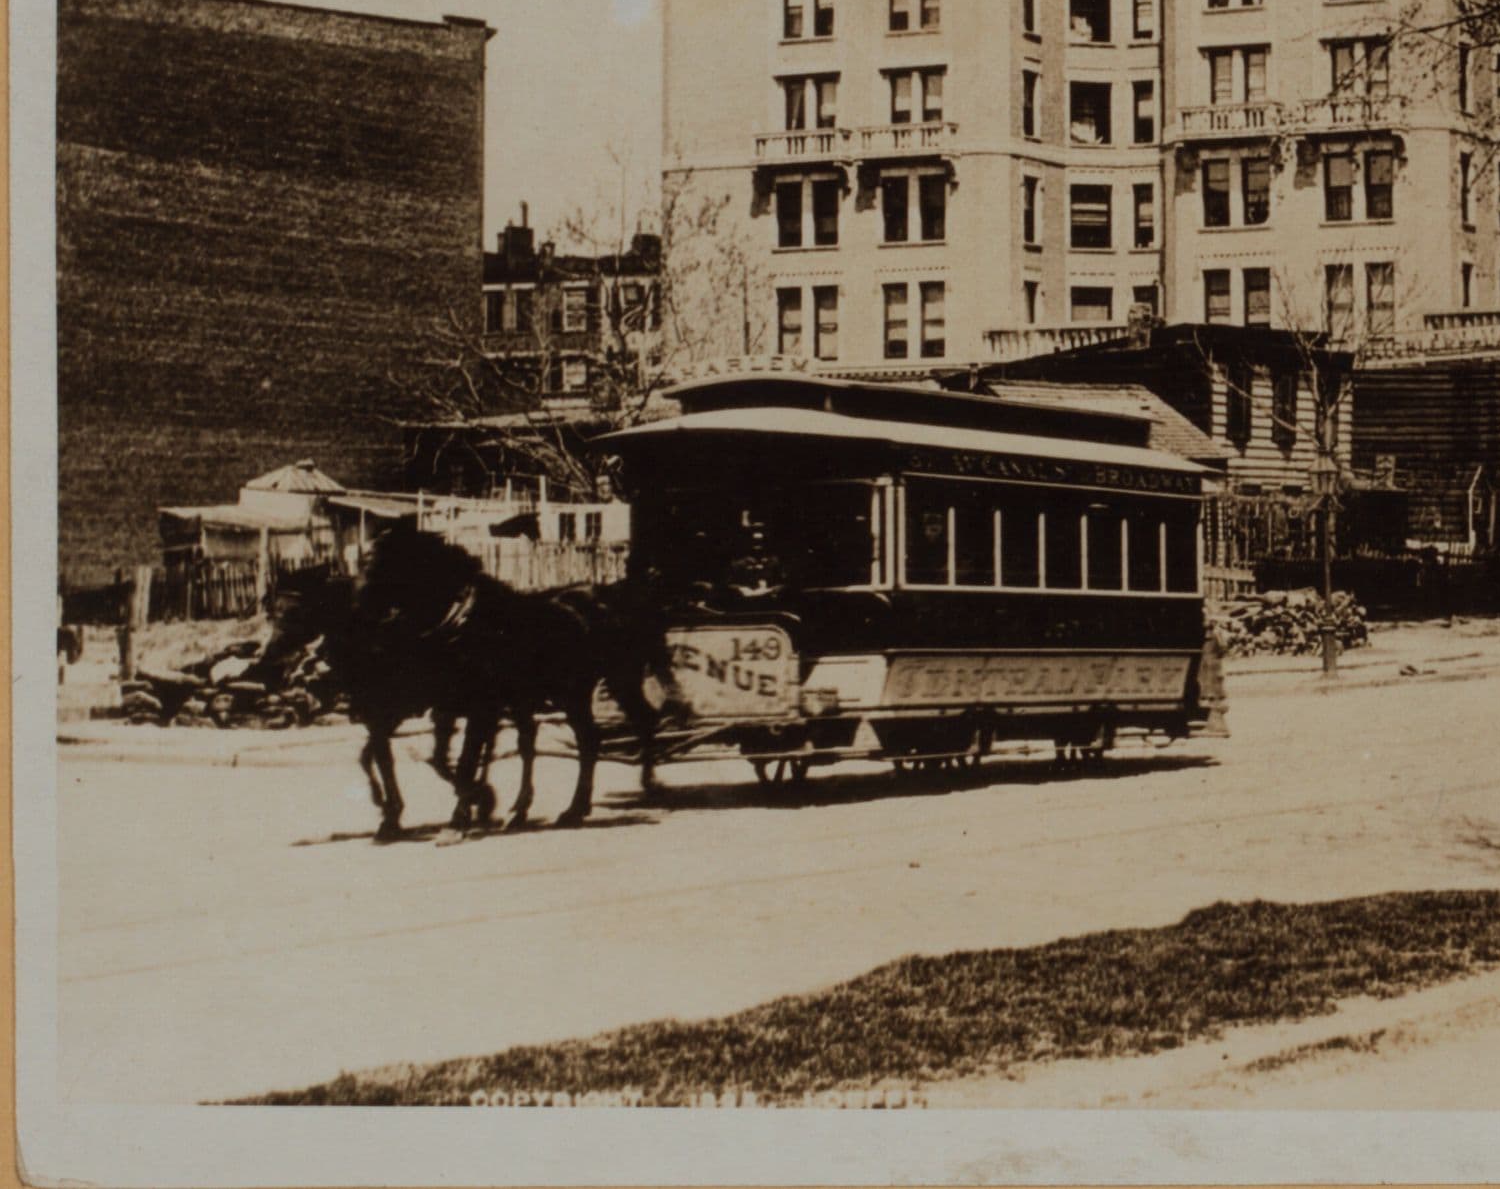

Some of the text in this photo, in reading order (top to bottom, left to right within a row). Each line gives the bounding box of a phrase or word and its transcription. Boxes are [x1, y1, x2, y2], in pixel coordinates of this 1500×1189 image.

[681, 356, 809, 381] HARLEM
[1094, 465, 1194, 493] BROADWAY
[730, 636, 783, 662] 149
[672, 644, 779, 697] ENUE
[898, 662, 1184, 698] CENTRAL PARK
